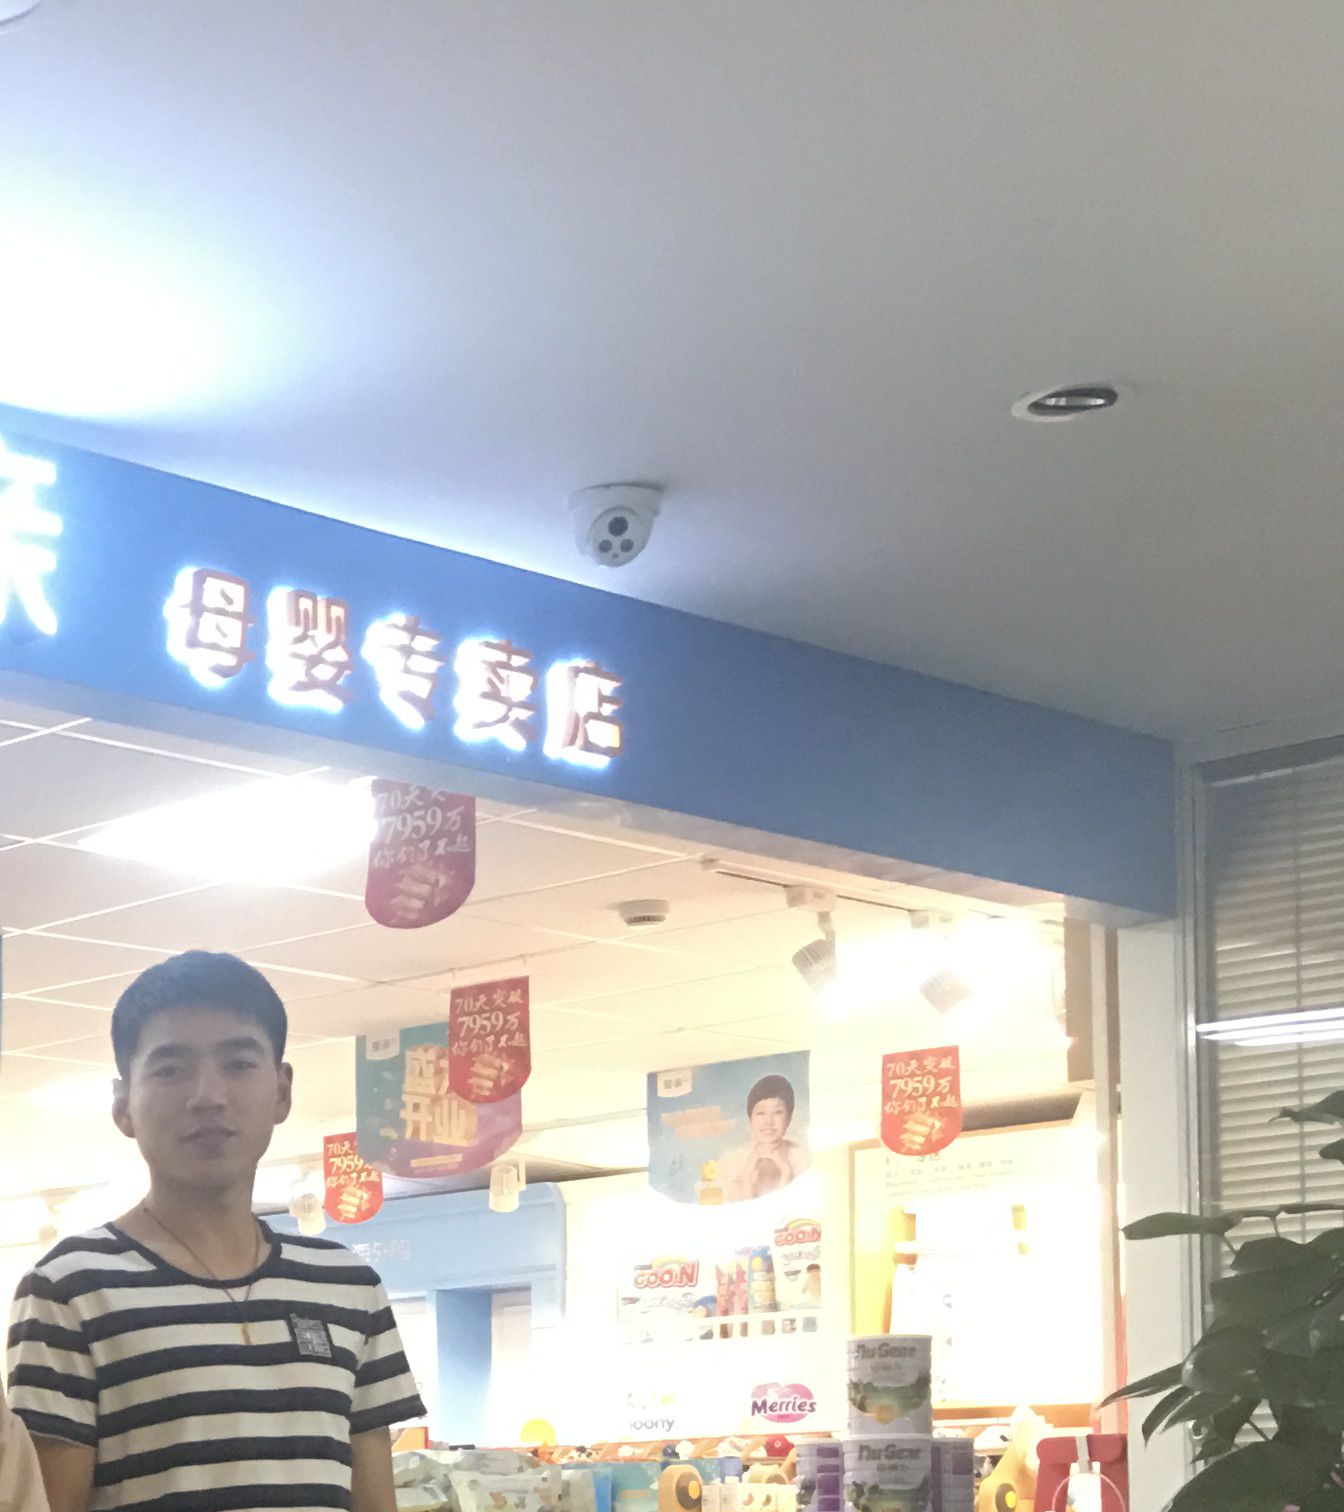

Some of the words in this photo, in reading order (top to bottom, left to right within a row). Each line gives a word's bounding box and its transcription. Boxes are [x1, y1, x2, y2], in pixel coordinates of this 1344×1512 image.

[162, 562, 628, 768] 母婴专卖店
[377, 805, 465, 845] 7959万
[457, 1009, 519, 1038] 7959万
[451, 1031, 527, 1057] 你们了不起
[886, 1054, 957, 1079] 70天突破
[889, 1075, 952, 1097] 7959万
[884, 1092, 959, 1116] 你们了不起
[399, 1094, 472, 1147] 开业
[328, 1153, 375, 1174] 7959
[750, 1395, 817, 1417] Merries
[628, 1416, 676, 1433] oony
